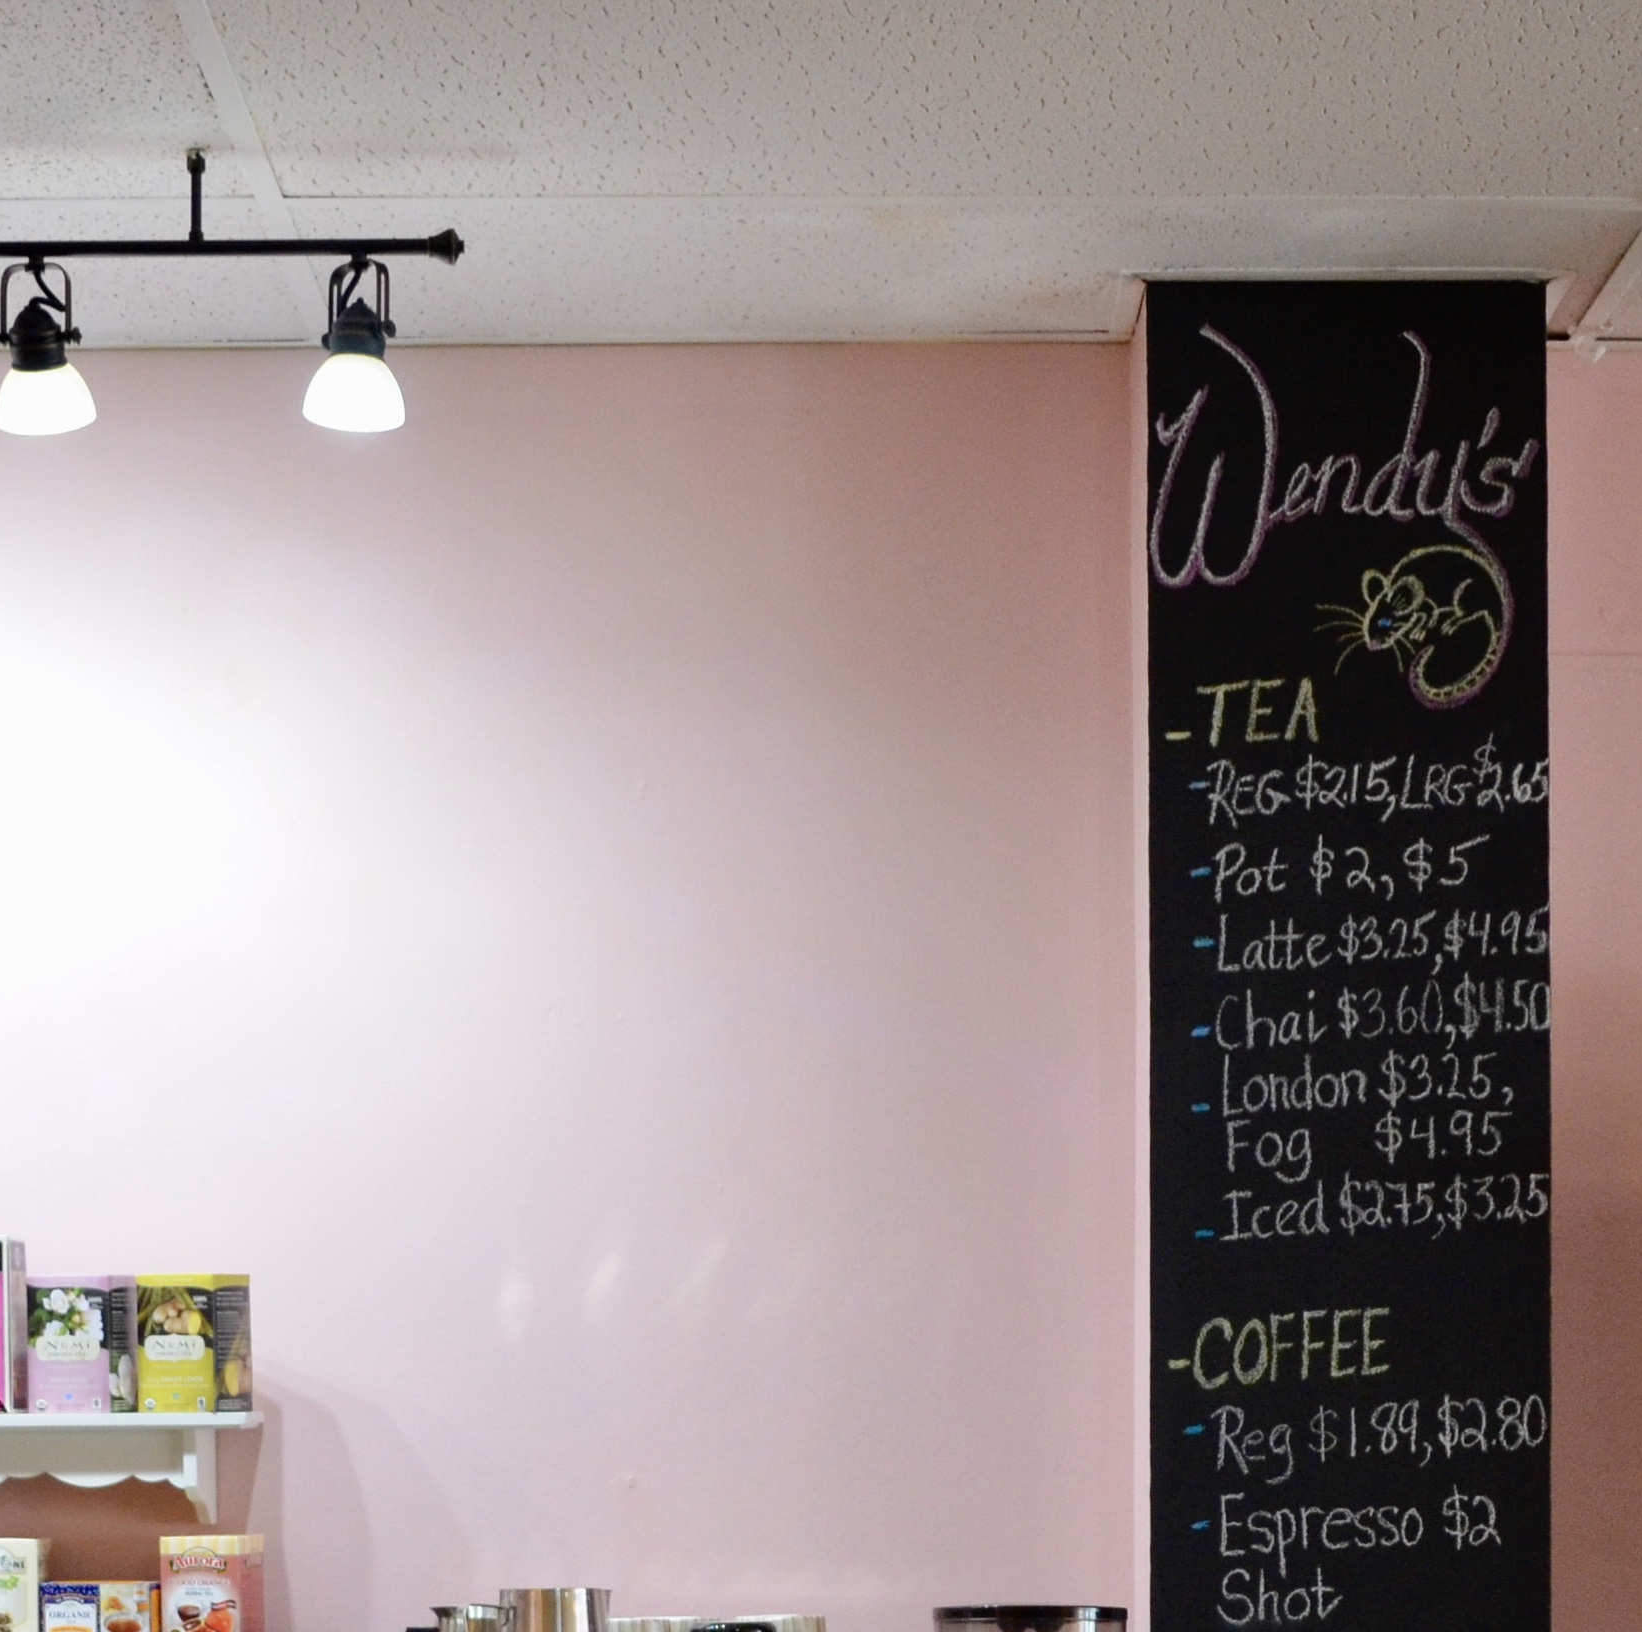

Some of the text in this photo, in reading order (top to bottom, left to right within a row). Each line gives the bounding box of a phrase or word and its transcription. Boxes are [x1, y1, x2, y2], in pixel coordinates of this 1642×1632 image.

[1151, 322, 1539, 620] Wendy's
[1207, 759, 1291, 829] REG
[1400, 754, 1474, 810] LRG
[1474, 732, 1549, 813] $2.65
[1212, 842, 1288, 903] Pot
[1403, 834, 1491, 892] $5
[1218, 914, 1332, 973] Latte
[1444, 903, 1549, 961] $4.95
[1216, 988, 1327, 1050] Chai
[1454, 972, 1551, 1040] $4.50
[1222, 1053, 1367, 1117] London
[1226, 1110, 1513, 1183] Fog $4.95
[1219, 1179, 1330, 1241] Iced
[1445, 1172, 1549, 1231] $3.25
[1192, 1307, 1391, 1390] COFFEE
[1211, 1405, 1293, 1484] Reg
[1438, 1394, 1547, 1458] $2.80
[175, 1554, 225, 1568] Aurora
[1220, 1484, 1502, 1578] Espresso $2
[49, 1610, 91, 1619] ORGANIC
[1217, 1567, 1343, 1627] Shot
